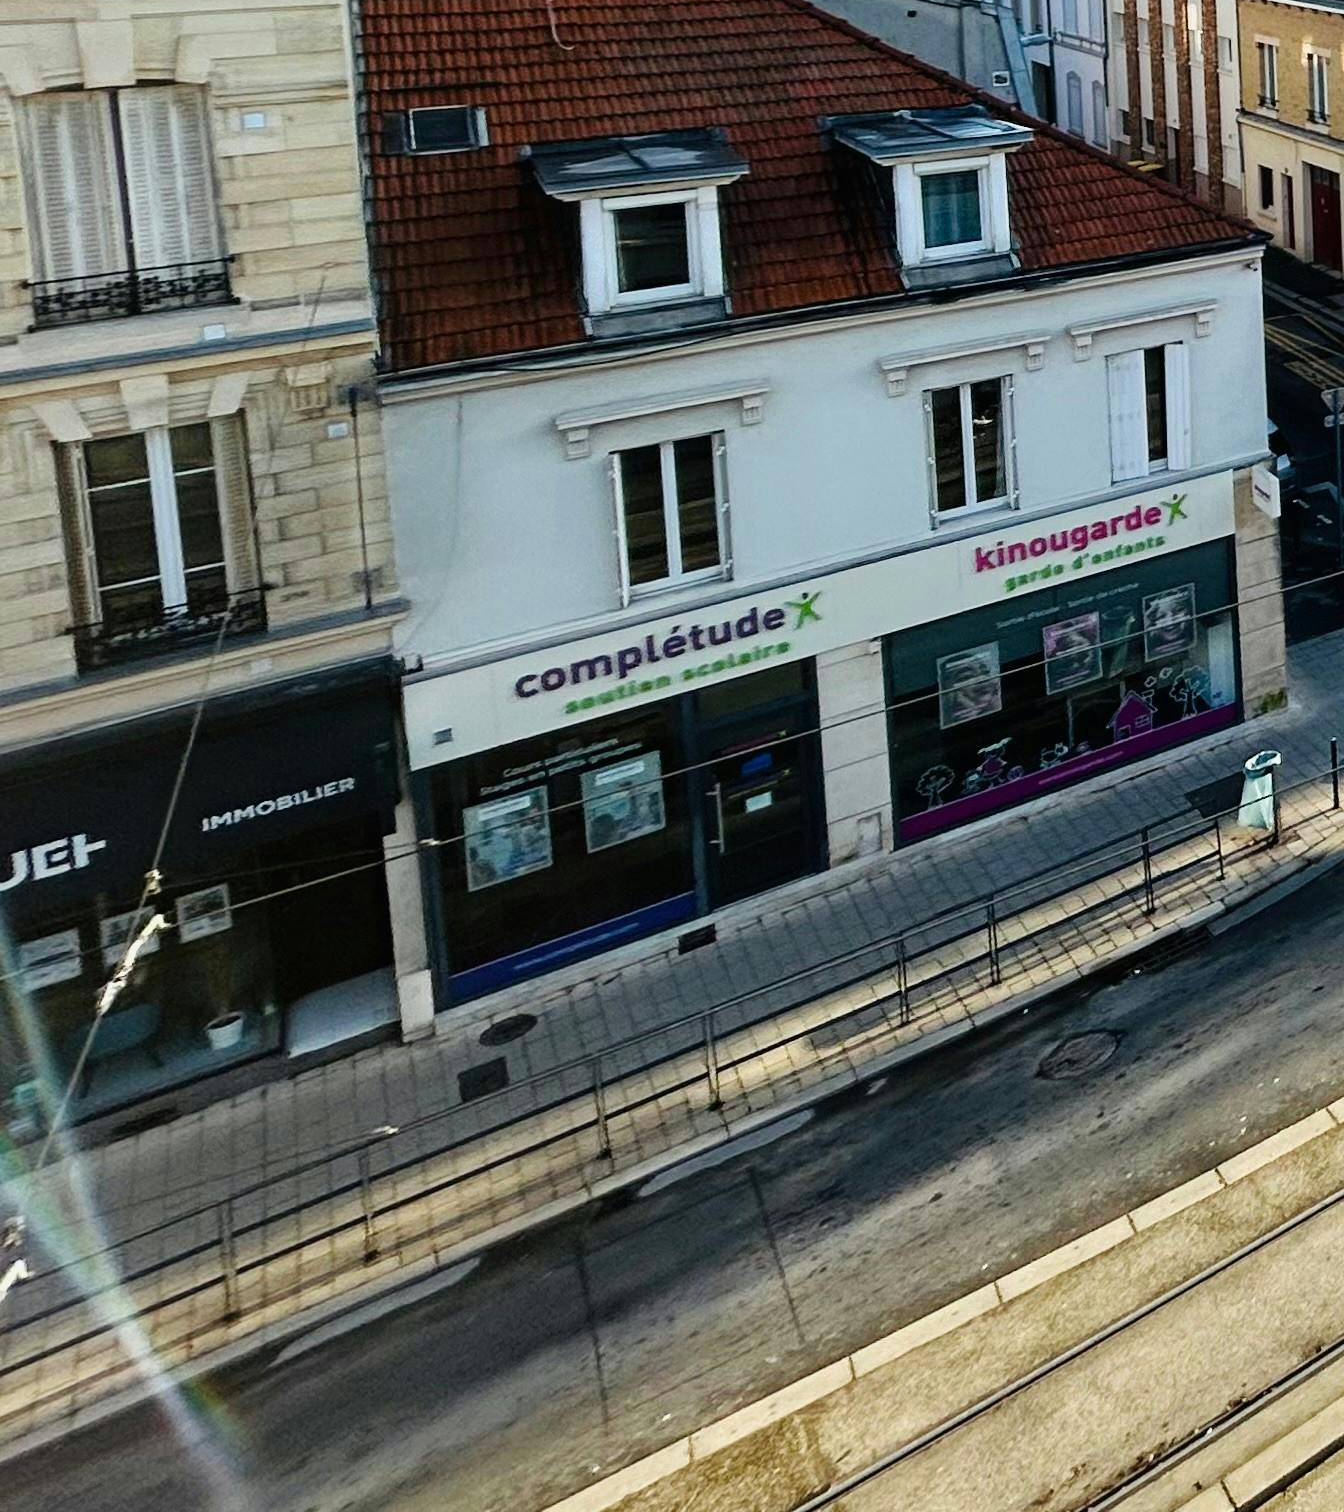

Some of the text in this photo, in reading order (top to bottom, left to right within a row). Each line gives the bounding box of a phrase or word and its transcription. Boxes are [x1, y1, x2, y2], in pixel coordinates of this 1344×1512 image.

[974, 505, 1163, 573] kinougarde
[1004, 562, 1064, 593] garde
[514, 606, 786, 699] complétude
[682, 640, 791, 682] scolaire
[201, 776, 356, 832] IMMOBILIER
